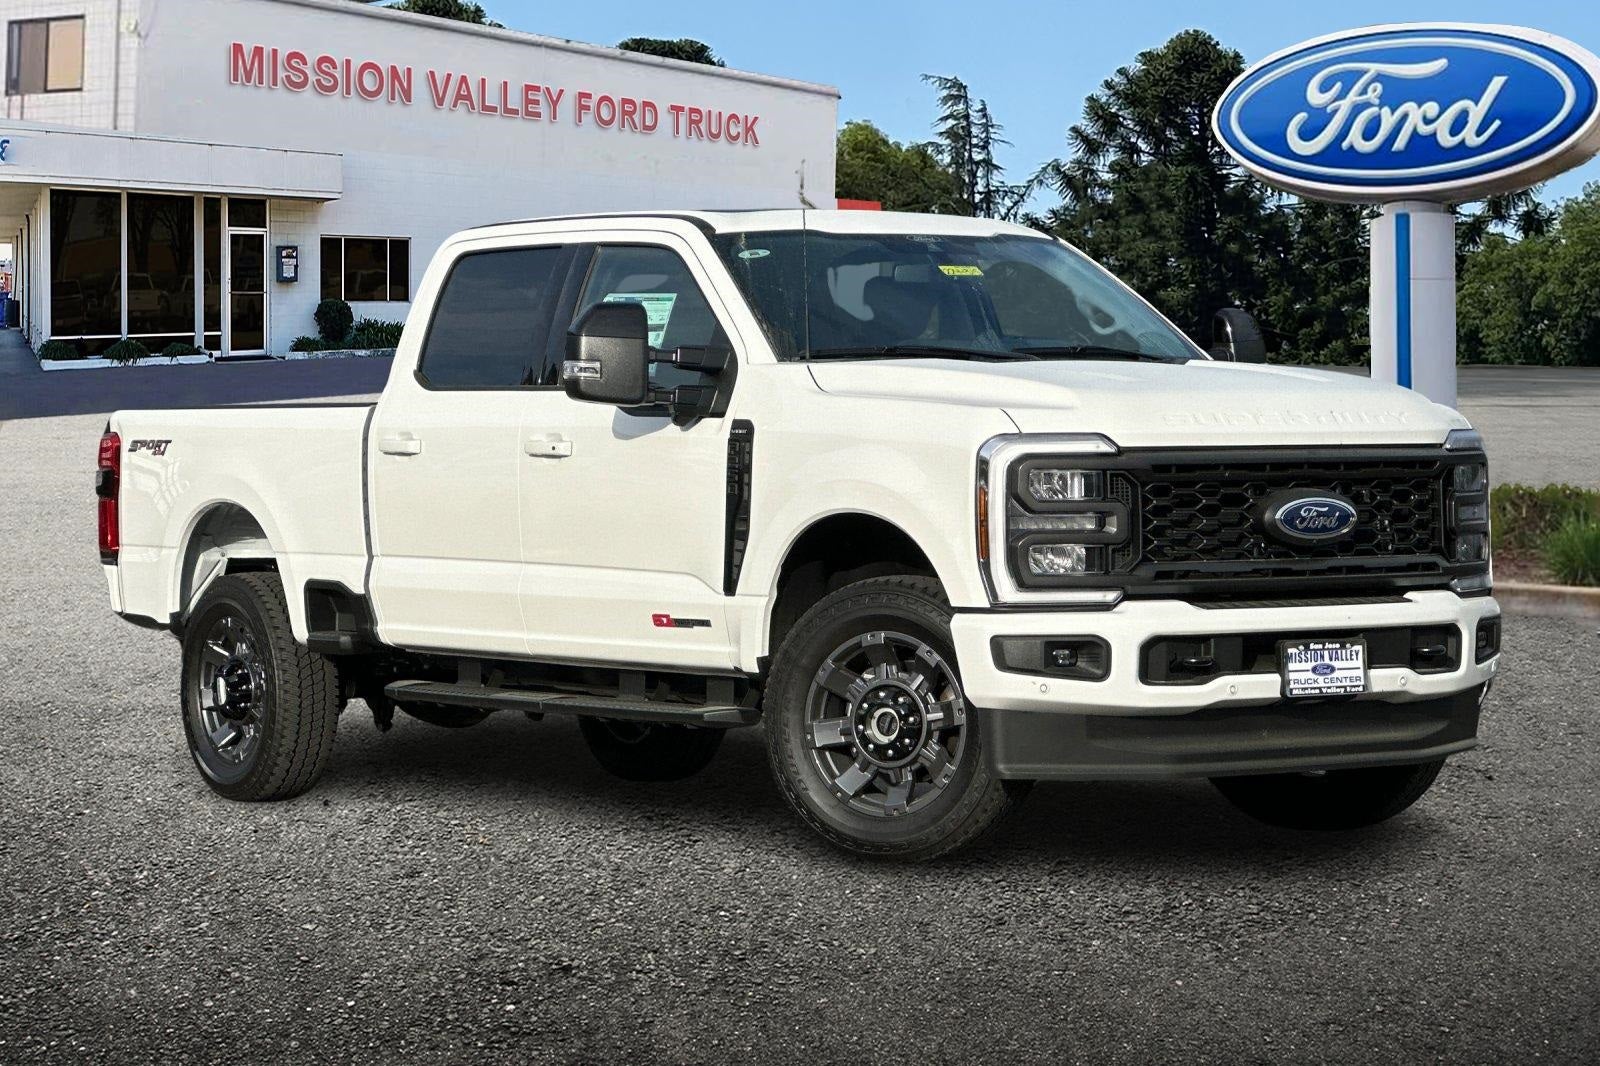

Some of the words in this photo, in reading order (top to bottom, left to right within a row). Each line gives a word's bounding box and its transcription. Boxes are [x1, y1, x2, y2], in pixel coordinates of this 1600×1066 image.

[229, 41, 414, 105] MISSION
[427, 69, 565, 122] VALLEY
[575, 90, 659, 133] FORD
[669, 103, 761, 146] TRUCK
[1286, 57, 1508, 156] Ford
[128, 439, 173, 454] SPORT
[1296, 506, 1340, 529] Ford
[1287, 650, 1325, 664] MISSION
[1327, 649, 1360, 662] VALLEY
[1323, 675, 1362, 684] CENTER
[1292, 687, 1320, 695] Mission
[1321, 686, 1345, 694] Valley
